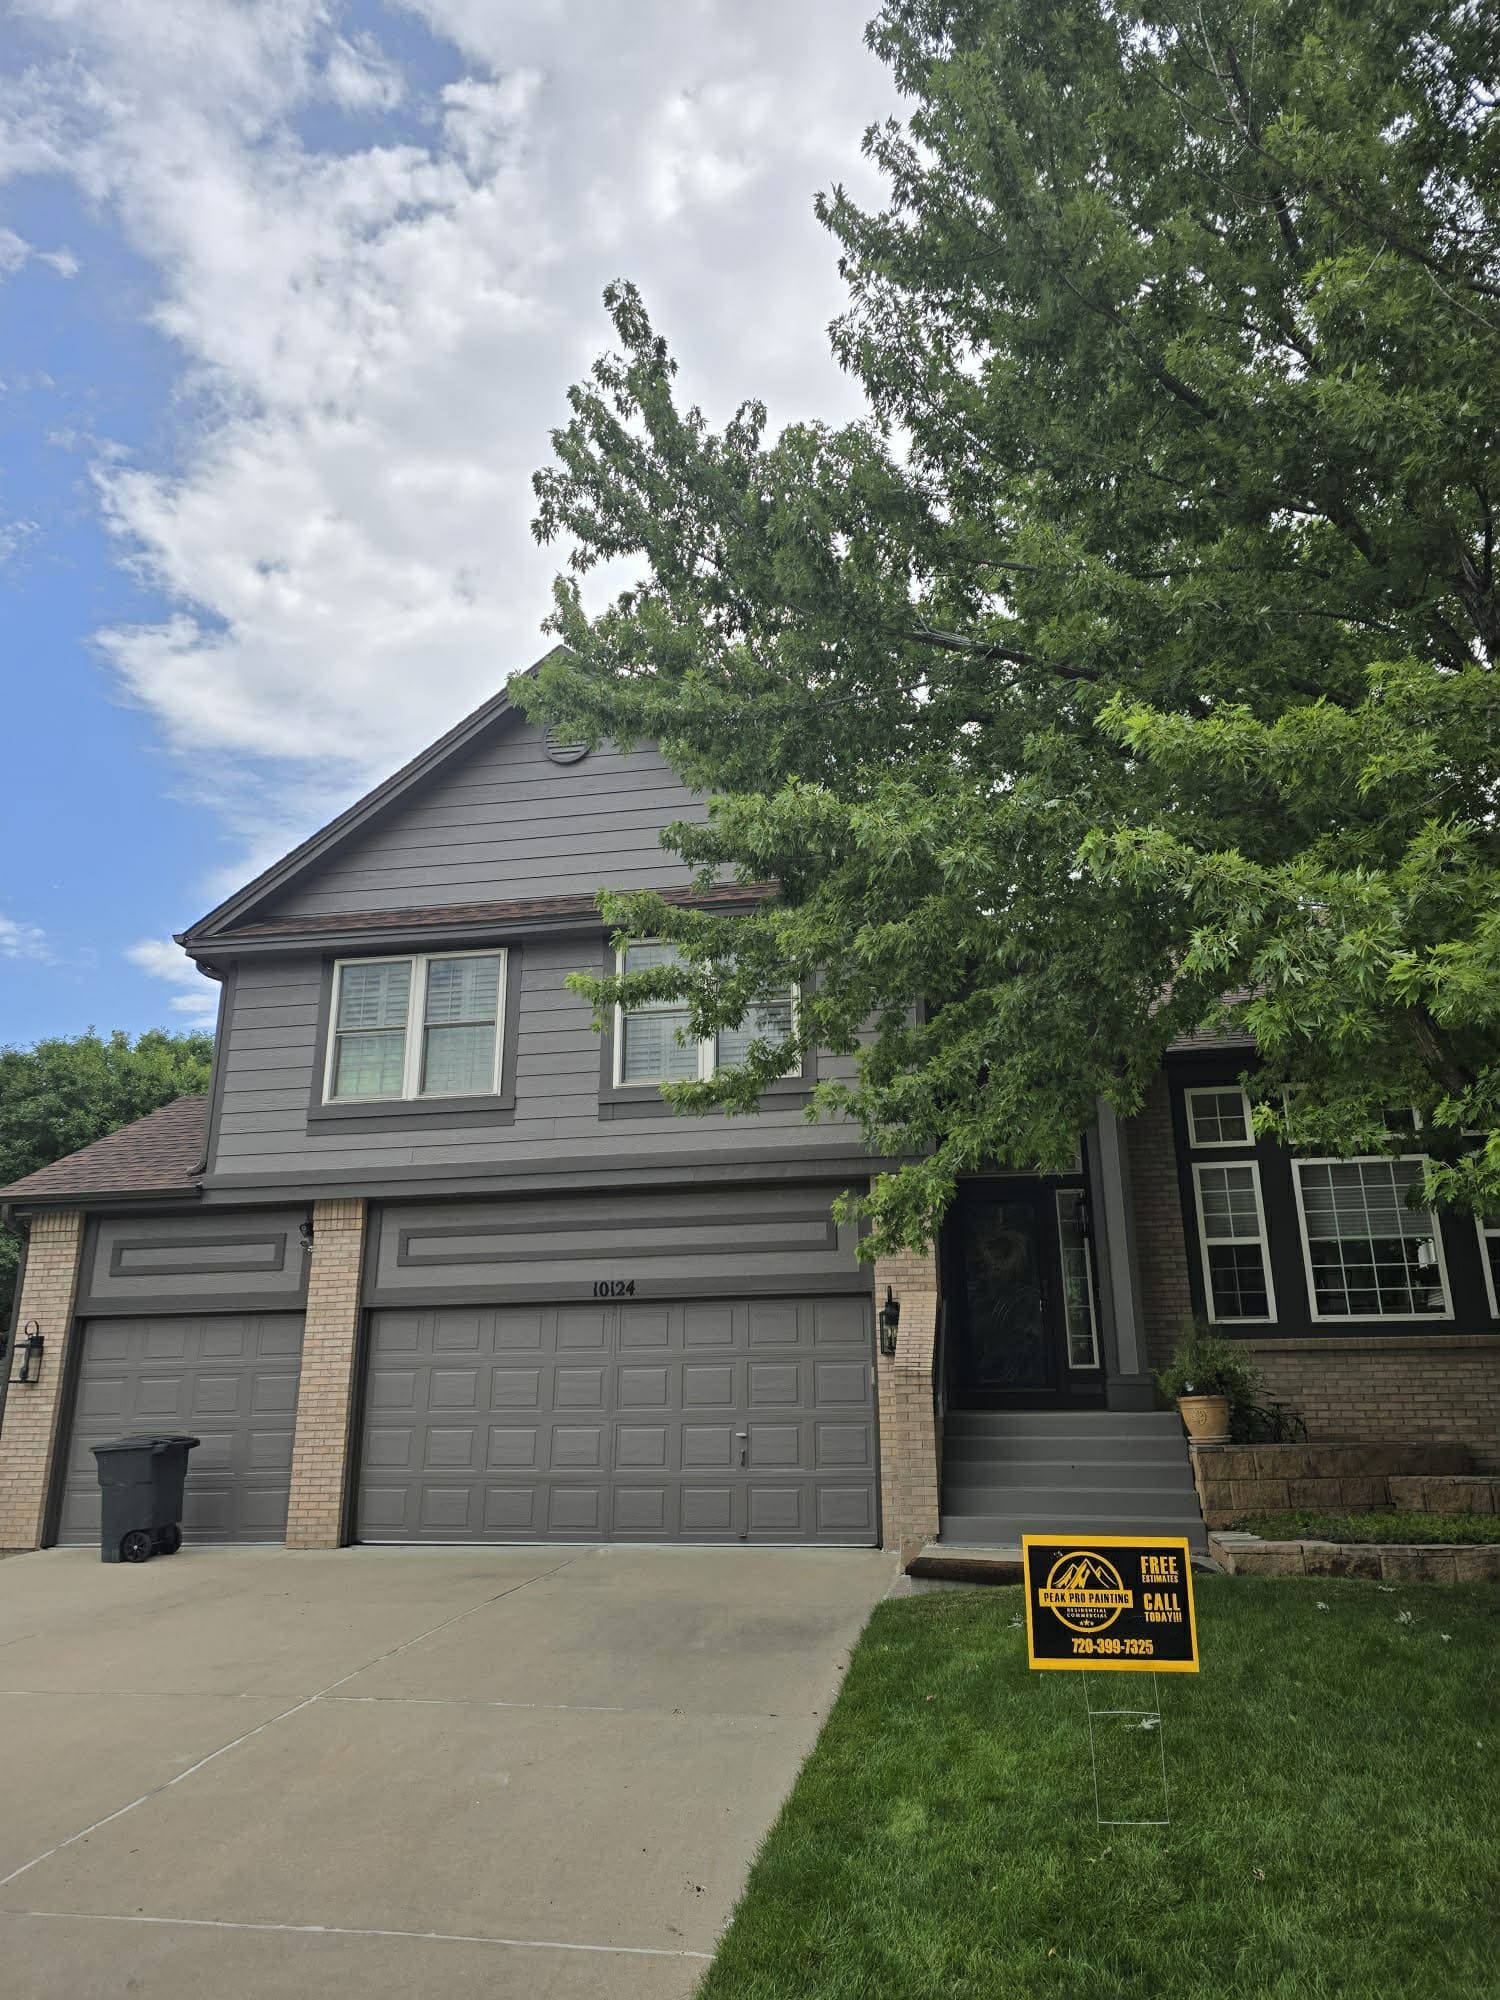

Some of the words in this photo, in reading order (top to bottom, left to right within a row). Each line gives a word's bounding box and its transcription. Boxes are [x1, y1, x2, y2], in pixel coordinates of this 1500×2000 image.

[593, 1279, 636, 1297] 10124
[1140, 1555, 1178, 1575] FREE
[1142, 1575, 1179, 1584] ESTIMATES
[1043, 1592, 1067, 1603] PEAK
[1069, 1593, 1086, 1604] PRO
[1088, 1593, 1129, 1604] PAINTING
[1143, 1593, 1181, 1611] CALL
[1071, 1637, 1154, 1655] 720-399-7325
